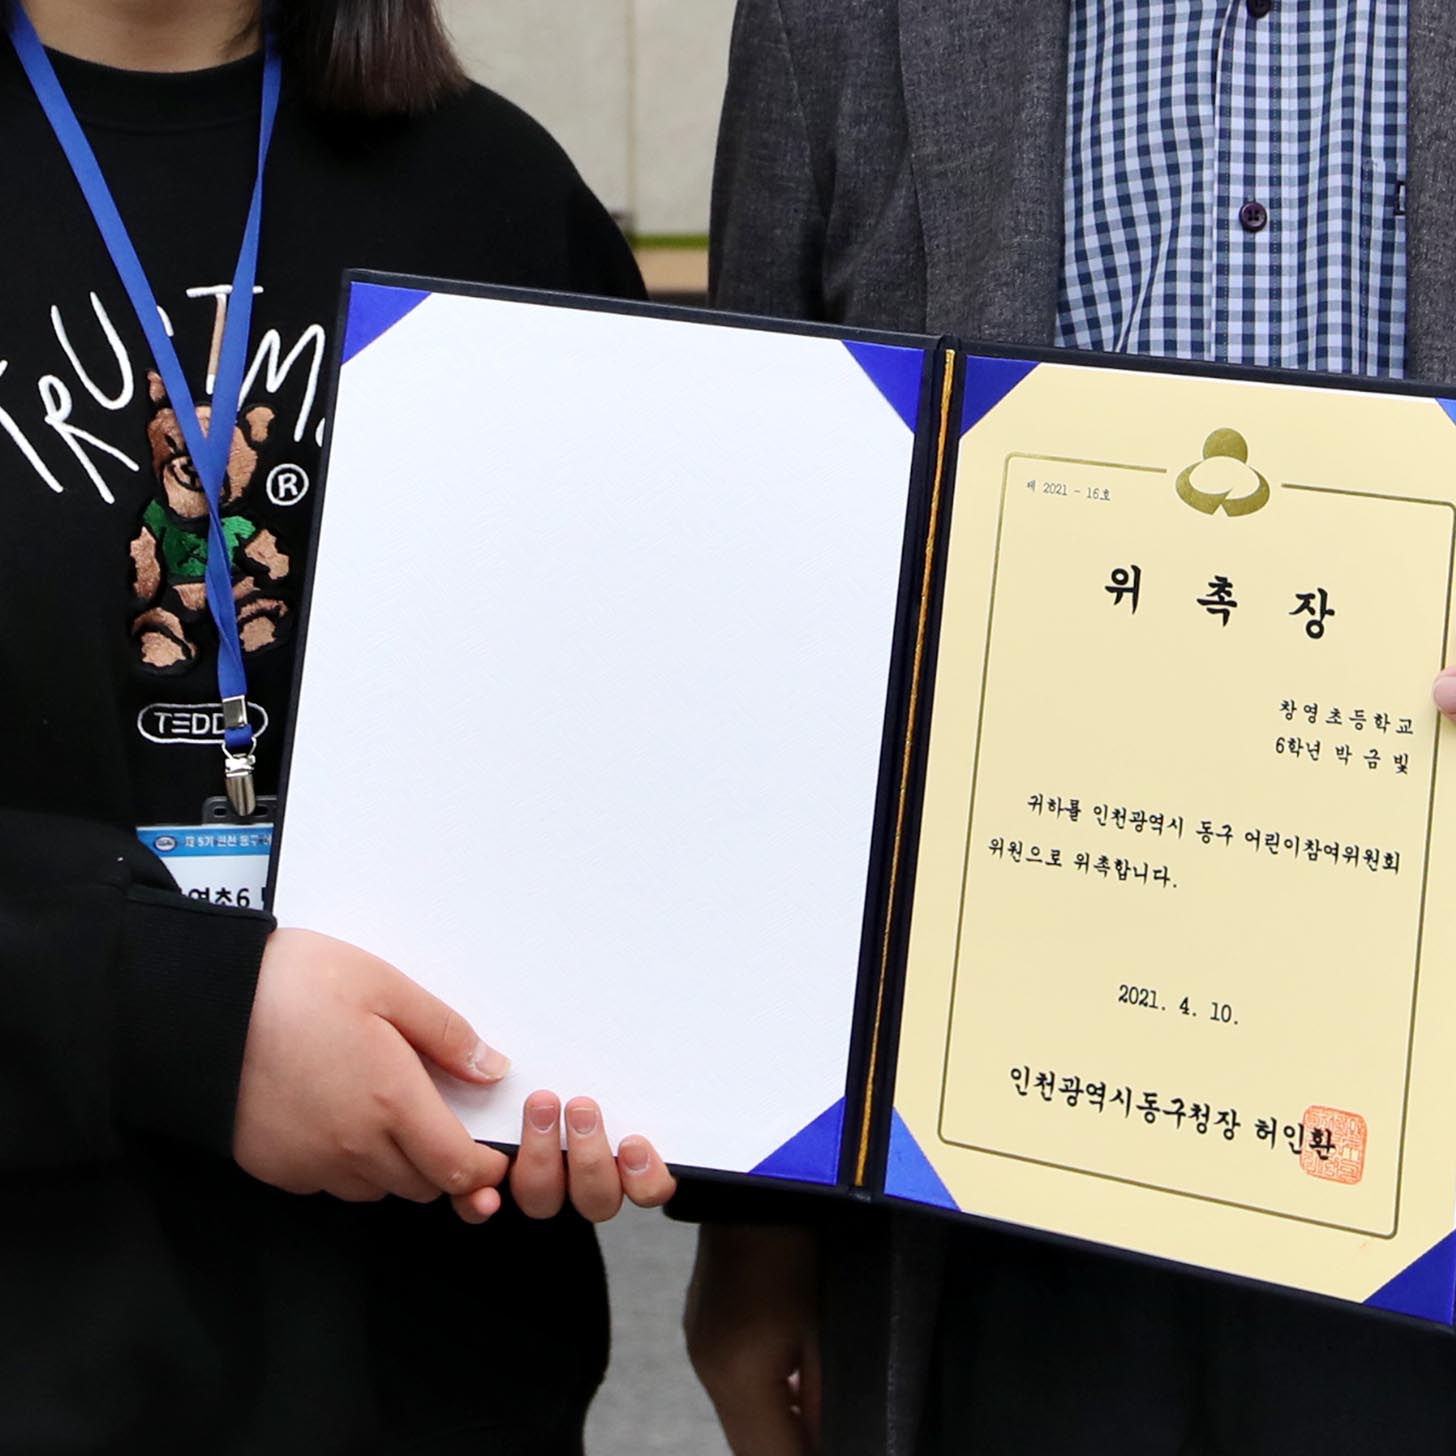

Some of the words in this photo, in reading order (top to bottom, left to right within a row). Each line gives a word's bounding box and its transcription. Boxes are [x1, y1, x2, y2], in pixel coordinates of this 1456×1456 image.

[238, 323, 325, 448] M
[1042, 481, 1068, 497] 2021
[153, 712, 227, 735] TEDD
[1280, 699, 1414, 735] 창영초등학교
[1275, 736, 1321, 762] 6학년
[1027, 793, 1082, 822] 귀하를
[1093, 804, 1184, 838] 인천광역시
[1195, 820, 1233, 846] 동구
[1244, 829, 1400, 874] 어린이참여위원회
[988, 837, 1062, 867] 위원으로
[1073, 852, 1177, 888] 위촉합니다.
[1118, 984, 1166, 1011] 2021.
[1179, 996, 1197, 1017] 4.
[1210, 1002, 1238, 1025] 10.
[1255, 1117, 1336, 1161] 허인환
